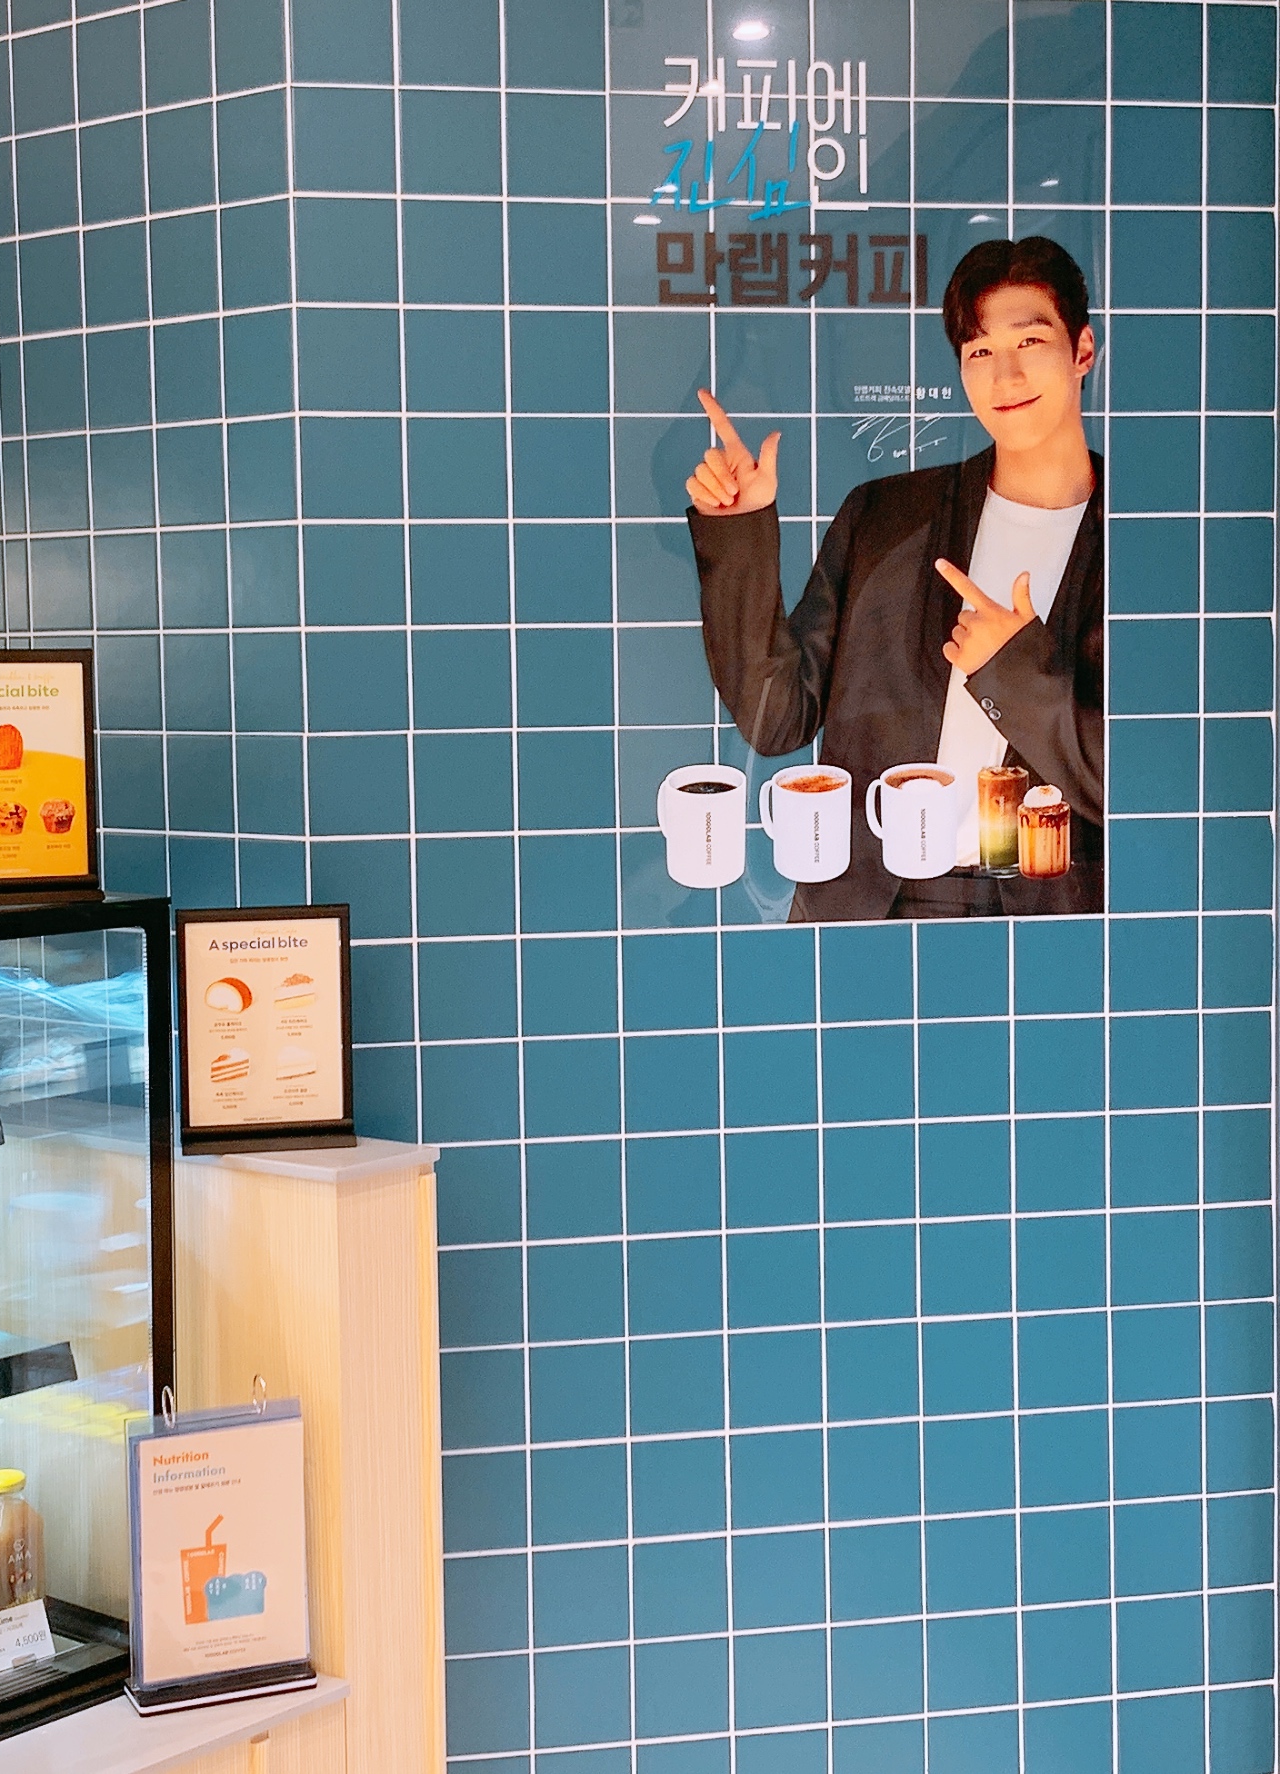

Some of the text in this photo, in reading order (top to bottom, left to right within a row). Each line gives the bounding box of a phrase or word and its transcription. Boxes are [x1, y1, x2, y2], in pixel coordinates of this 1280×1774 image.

[663, 57, 868, 134] 커피에
[656, 232, 929, 306] 만랩커피
[26, 684, 59, 698] bite
[209, 936, 309, 953] A special bite
[153, 1451, 209, 1466] Nutrition
[153, 1465, 226, 1483] Information
[15, 1629, 46, 1648] 4,500원
